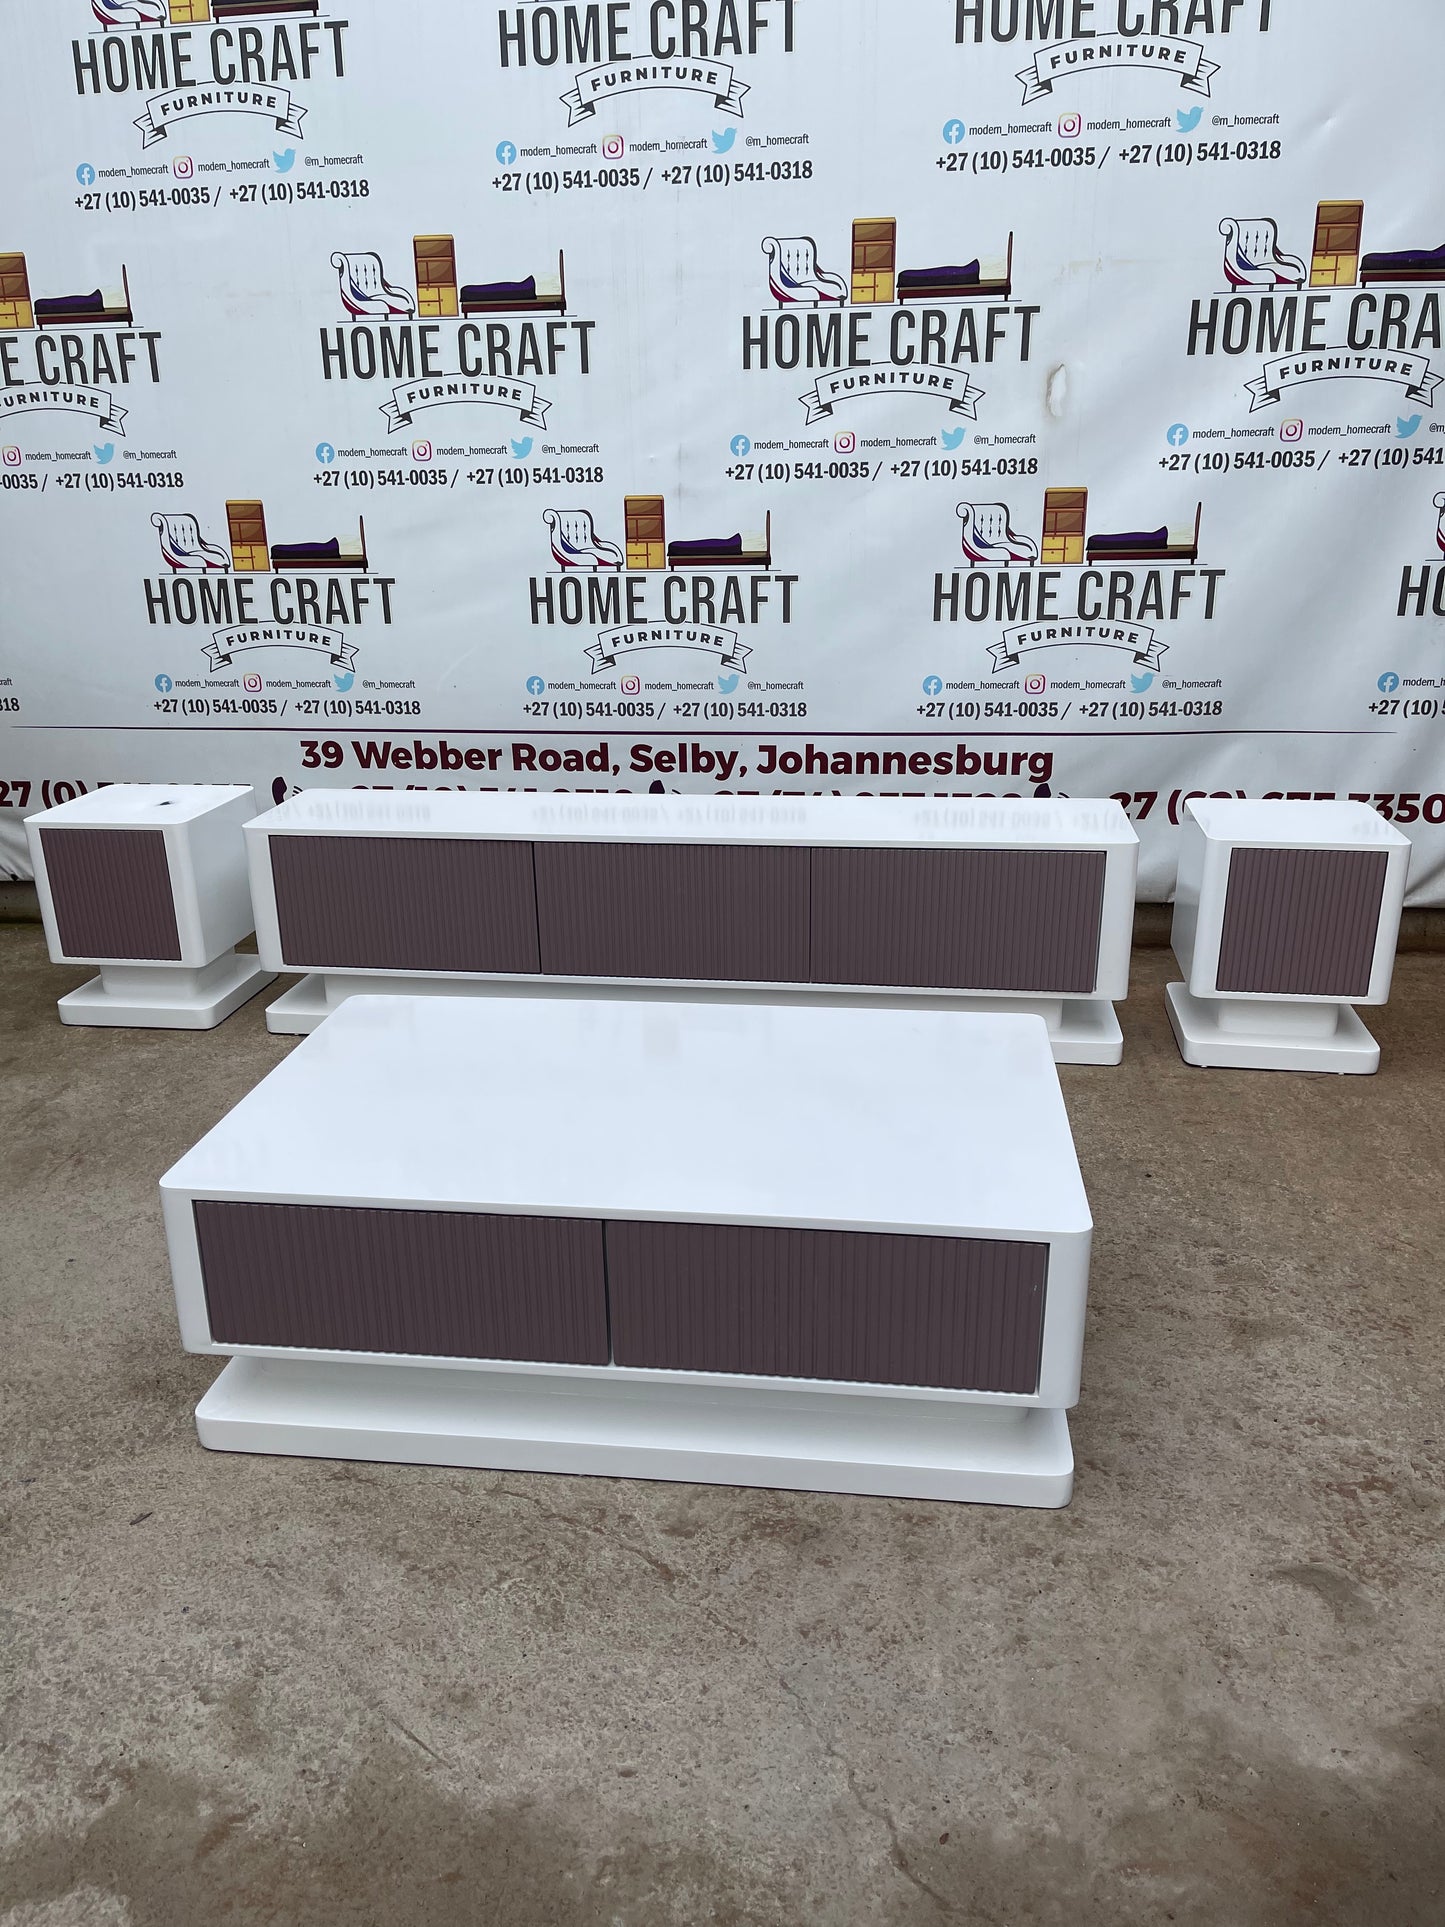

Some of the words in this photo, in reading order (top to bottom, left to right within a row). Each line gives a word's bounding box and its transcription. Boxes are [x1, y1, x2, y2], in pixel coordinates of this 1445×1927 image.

[498, 2, 632, 68] HOME
[650, 0, 796, 60] CRAFT
[71, 31, 197, 95] HOME
[210, 20, 349, 85] CRAFT
[1050, 44, 1186, 70] FURNITURE
[591, 66, 718, 92] FURNITURE
[160, 91, 276, 116] FURNITURE
[1211, 113, 1280, 128] @m_homecraft
[745, 133, 809, 148] @m_homecraft
[304, 154, 364, 168] @m_homecraft
[936, 152, 968, 172] +27
[972, 150, 1008, 175] (10)
[1012, 147, 1096, 169] 541-0035
[1119, 144, 1153, 164] +27
[1156, 143, 1193, 167] (10)
[1196, 140, 1281, 161] 541-0318
[492, 173, 522, 191] +27
[526, 171, 559, 195] (10)
[563, 168, 640, 189] 541-0035
[661, 165, 692, 184] +27
[696, 164, 730, 188] (10)
[734, 160, 813, 182] 541-0318
[75, 193, 101, 210] +27
[105, 191, 136, 213] (10)
[139, 187, 210, 207] 541-0035
[229, 184, 257, 202] +27
[261, 182, 293, 205] (10)
[296, 179, 369, 200] 541-0318
[1187, 295, 1331, 356] HOME
[1347, 293, 1441, 351] CRA
[743, 312, 872, 370] HOME
[890, 305, 1041, 366] CRAFT
[35, 332, 162, 386] CRAFT
[320, 325, 443, 380] HOME
[458, 321, 596, 377] CRAFT
[1279, 357, 1413, 380] FURNITURE
[406, 383, 522, 404] FURNITURE
[830, 372, 954, 394] FURNITURE
[0, 391, 99, 409] URNITURE
[541, 443, 600, 455] @m_homecraft
[974, 433, 1036, 446] @m_homecraft
[123, 450, 177, 461] @m_homecraft
[1159, 453, 1191, 471] +27
[1194, 452, 1230, 474] (10)
[1233, 450, 1315, 469] 541-0035
[1338, 449, 1372, 466] +27
[1374, 448, 1409, 470] (10)
[55, 473, 81, 488] +27
[85, 473, 114, 492] (10)
[117, 472, 184, 488] 541-0318
[313, 470, 340, 486] +27
[344, 470, 374, 490] (10)
[377, 469, 448, 486] 541-0035
[466, 468, 494, 484] +27
[498, 468, 529, 488] (10)
[533, 466, 604, 484] 541-0318
[725, 464, 754, 480] +27
[758, 463, 790, 484] (10)
[794, 461, 870, 479] 541-0035
[890, 460, 921, 477] +27
[924, 459, 957, 480] (10)
[961, 457, 1038, 476] 541-0318
[143, 578, 259, 625] HOME
[270, 578, 396, 625] CRAFT
[529, 576, 648, 625] HOME
[664, 575, 799, 625] CRAFT
[933, 571, 1061, 622] HOME
[1077, 569, 1226, 621] CRAFT
[226, 629, 331, 647] FURNITURE
[611, 630, 724, 648] FURNITURE
[1017, 626, 1139, 645] FURNITURE
[362, 680, 416, 690] @m_homecraft
[747, 681, 804, 692] @m_homecraft
[1162, 679, 1222, 690] @m_homecraft
[153, 699, 178, 713] +27
[182, 699, 210, 716] (10)
[212, 699, 277, 714] 541-0035
[294, 699, 320, 714] +27
[323, 700, 352, 718] (10)
[355, 700, 421, 715] 541-0318
[523, 701, 549, 716] +27
[553, 702, 583, 720] (10)
[586, 702, 655, 717] 541-0035
[673, 702, 700, 717] +27
[704, 702, 734, 720] (10)
[737, 702, 807, 717] 541-0318
[916, 702, 946, 717] +27
[949, 702, 981, 721] (10)
[984, 702, 1058, 717] 541-0035
[1079, 702, 1109, 717] +27
[1112, 701, 1145, 720] (10)
[1148, 700, 1223, 717] 541-0318
[1368, 699, 1400, 715] +27
[1403, 699, 1441, 719] (10)
[300, 740, 344, 769] 39
[350, 740, 503, 771] Webber
[511, 742, 620, 776] Road,
[629, 742, 748, 781] Selby,
[756, 743, 1053, 783] Johannesburg
[1348, 793, 1445, 824] 350
